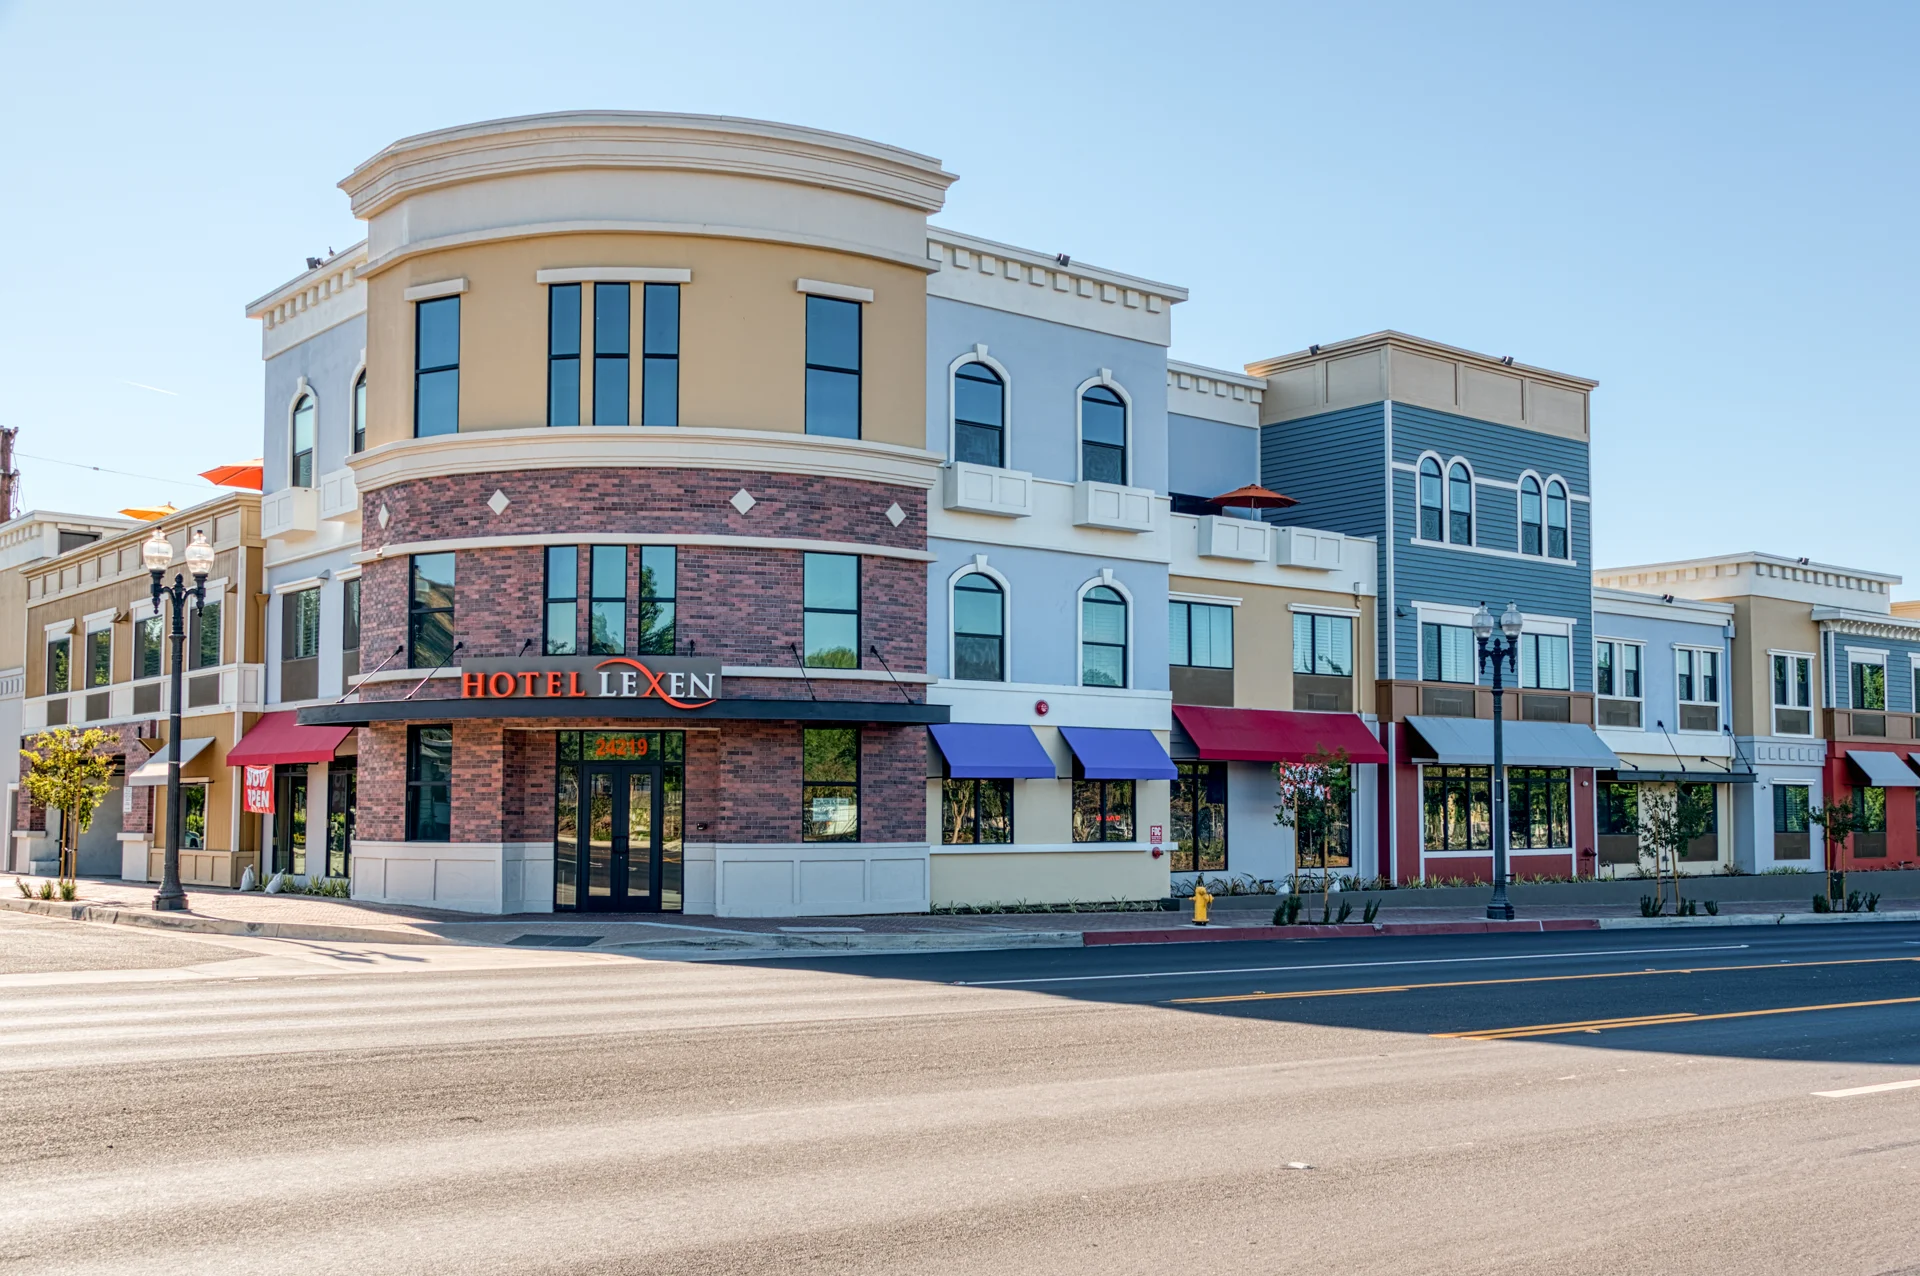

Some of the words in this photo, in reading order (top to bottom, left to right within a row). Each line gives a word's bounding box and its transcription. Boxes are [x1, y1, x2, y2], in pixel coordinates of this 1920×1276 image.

[462, 671, 586, 698] HOTEL
[594, 659, 716, 707] LEXEN
[596, 738, 648, 756] 24219
[246, 768, 270, 787] NOW
